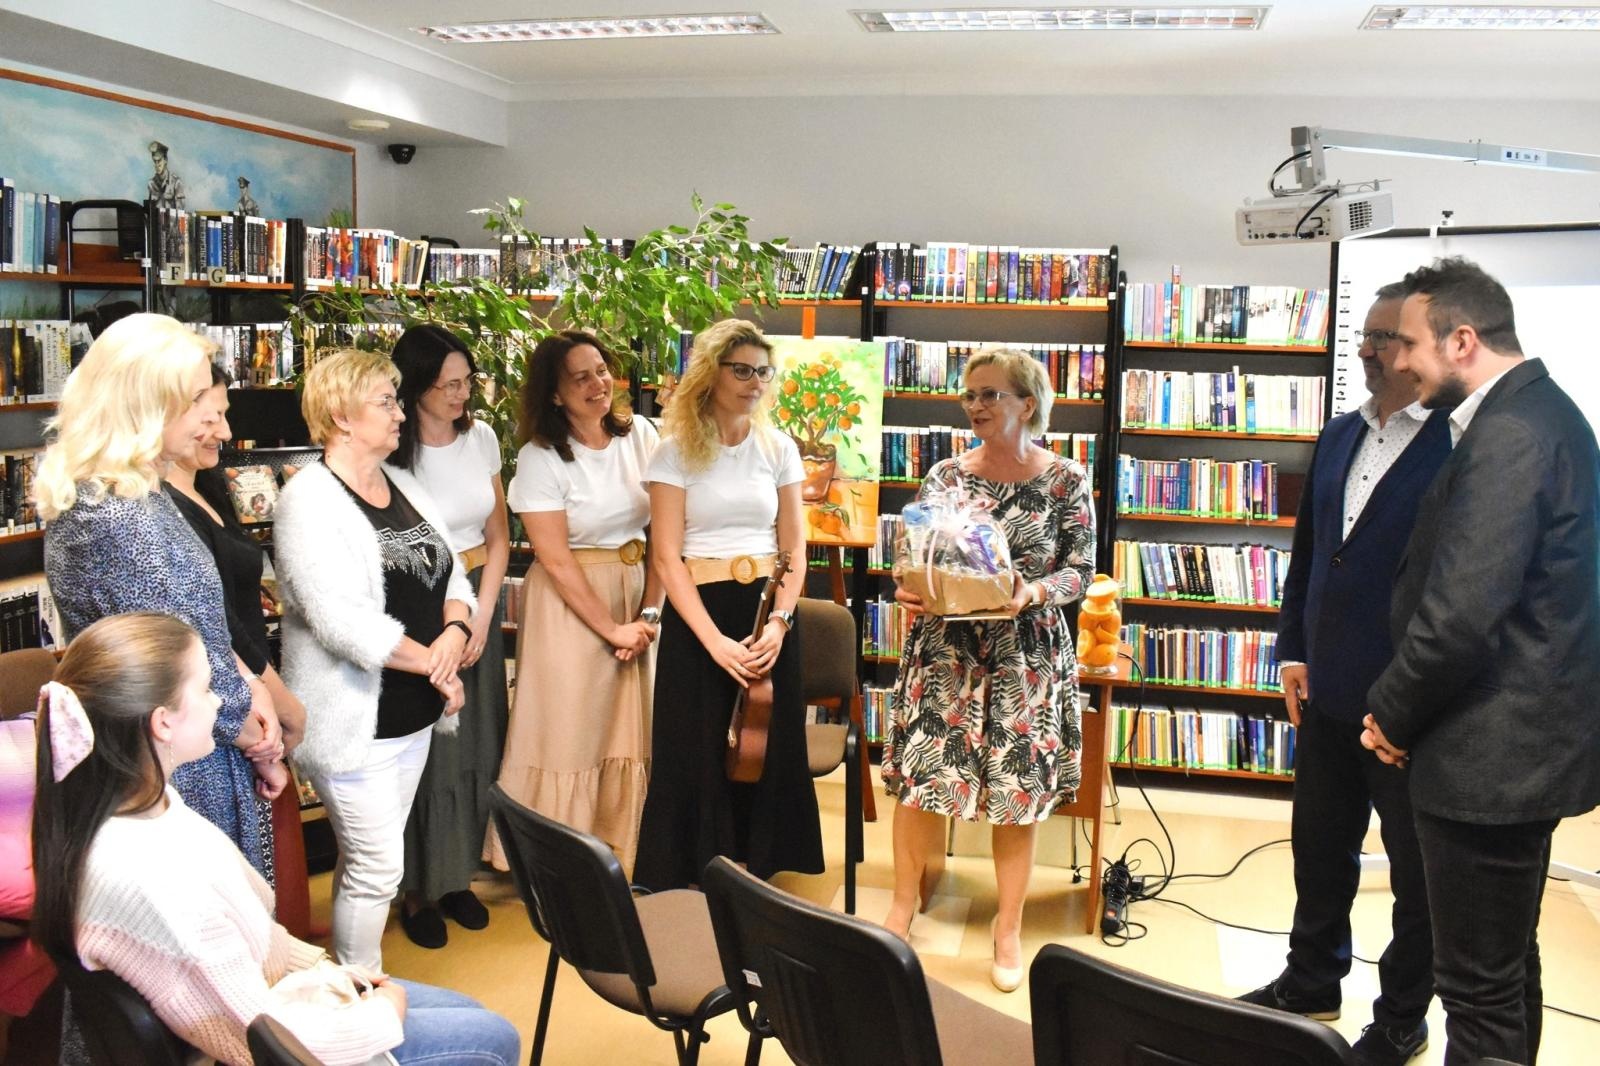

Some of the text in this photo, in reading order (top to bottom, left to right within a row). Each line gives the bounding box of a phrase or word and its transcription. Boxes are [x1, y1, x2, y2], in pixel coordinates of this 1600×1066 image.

[171, 266, 181, 280] F
[211, 268, 223, 283] G
[256, 371, 265, 385] H
